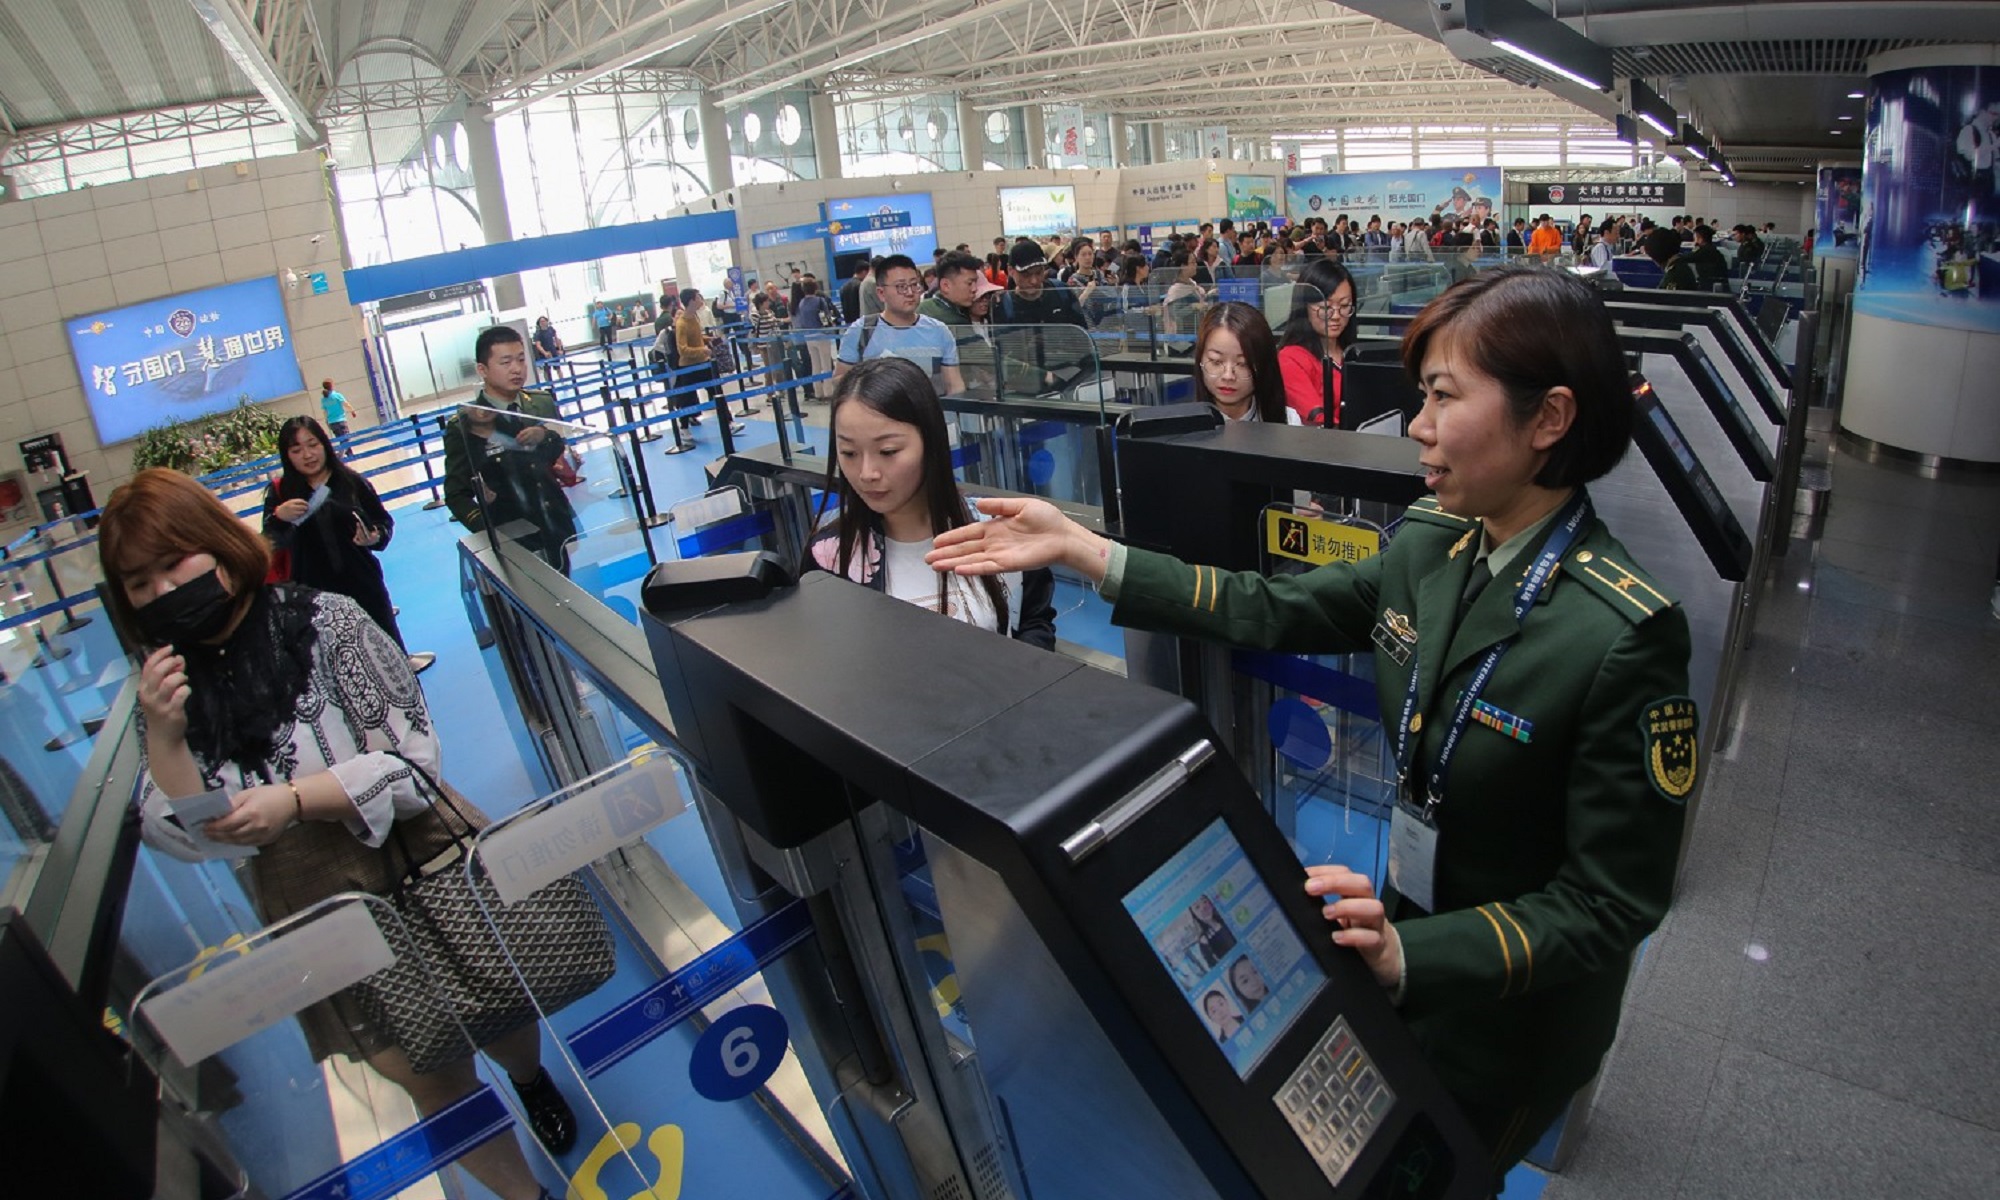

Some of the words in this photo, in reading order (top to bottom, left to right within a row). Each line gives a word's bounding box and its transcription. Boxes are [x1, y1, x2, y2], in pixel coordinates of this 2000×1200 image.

[1578, 185, 1664, 196] 大件行李检查室
[1230, 285, 1246, 294] 出口
[92, 350, 186, 396] 智守国门
[197, 325, 285, 372] 慧通世界
[1312, 533, 1370, 561] 请勿推门
[1520, 551, 1556, 602] 青岛国际机场
[1456, 652, 1497, 724] INTERNATIONAL
[1440, 726, 1458, 766] AIRPORT
[719, 1026, 760, 1077] 6
